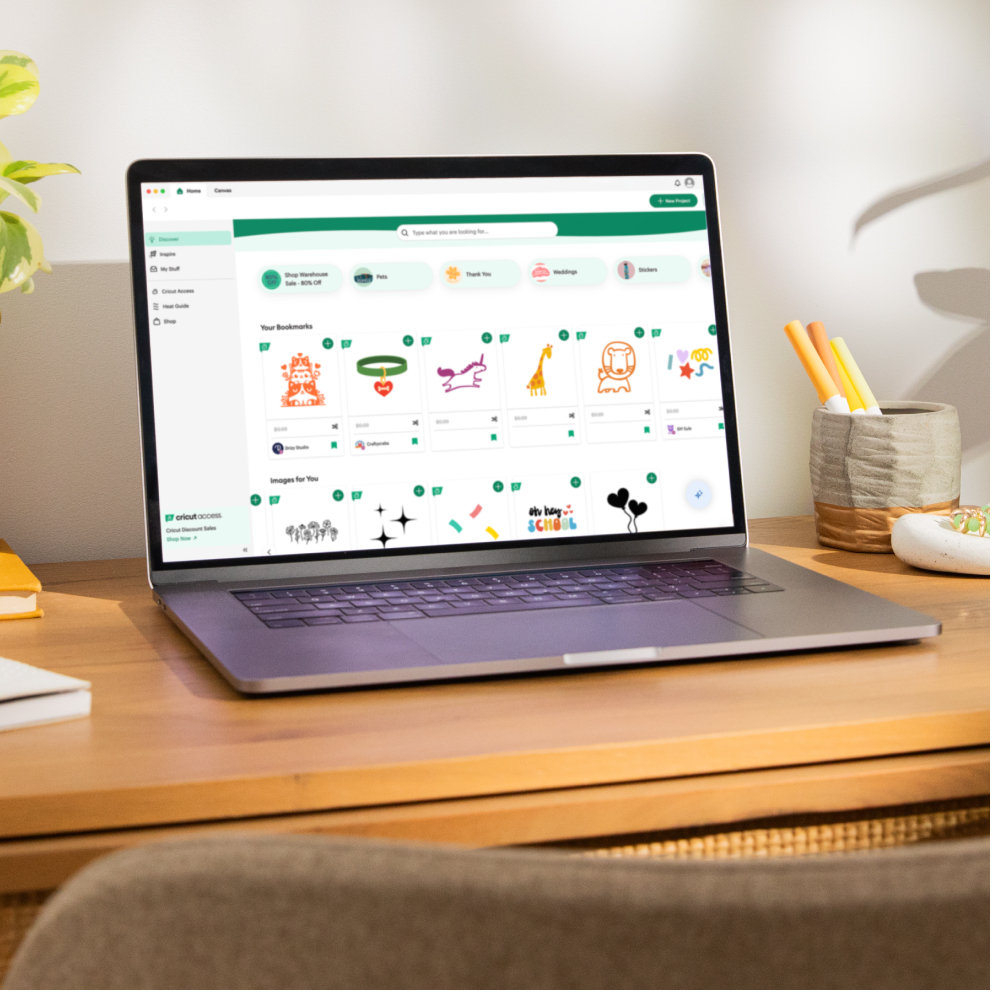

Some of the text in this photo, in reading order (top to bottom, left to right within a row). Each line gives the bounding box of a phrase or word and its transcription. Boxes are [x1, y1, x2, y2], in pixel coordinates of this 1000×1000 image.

[276, 323, 313, 331] Bookmarks
[270, 477, 294, 485] Images
[544, 505, 562, 519] hey
[176, 513, 197, 521] cricut
[527, 517, 577, 533] SCHOOL
